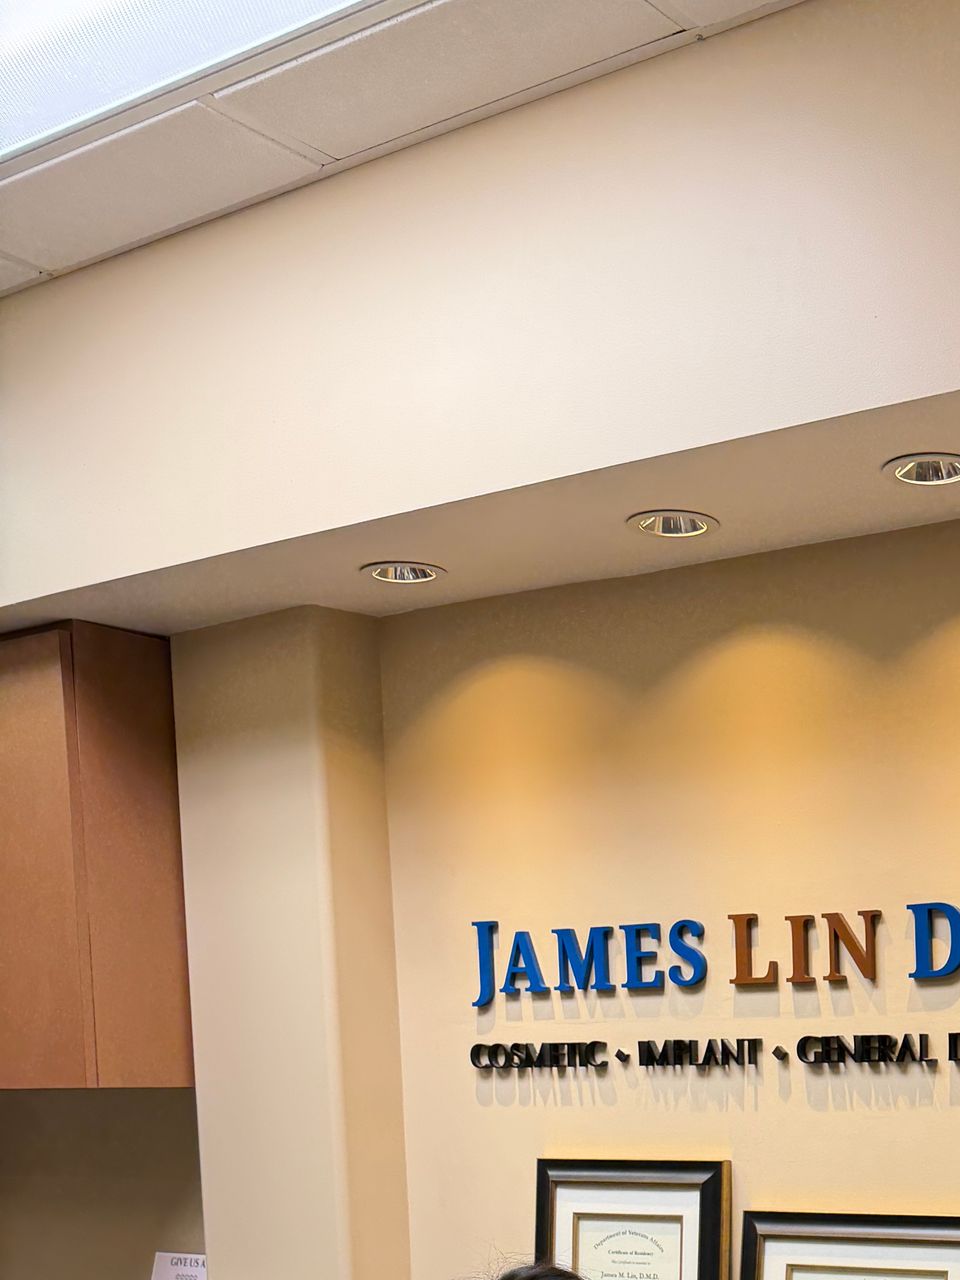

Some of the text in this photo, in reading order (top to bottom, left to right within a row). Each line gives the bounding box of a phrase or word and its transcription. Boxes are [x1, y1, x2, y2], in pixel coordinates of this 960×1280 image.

[471, 919, 707, 1007] JAMES
[728, 909, 882, 985] LIN
[470, 1040, 608, 1069] COSMETIC
[638, 1038, 763, 1066] IMPLANT
[797, 1033, 938, 1064] GENERAL
